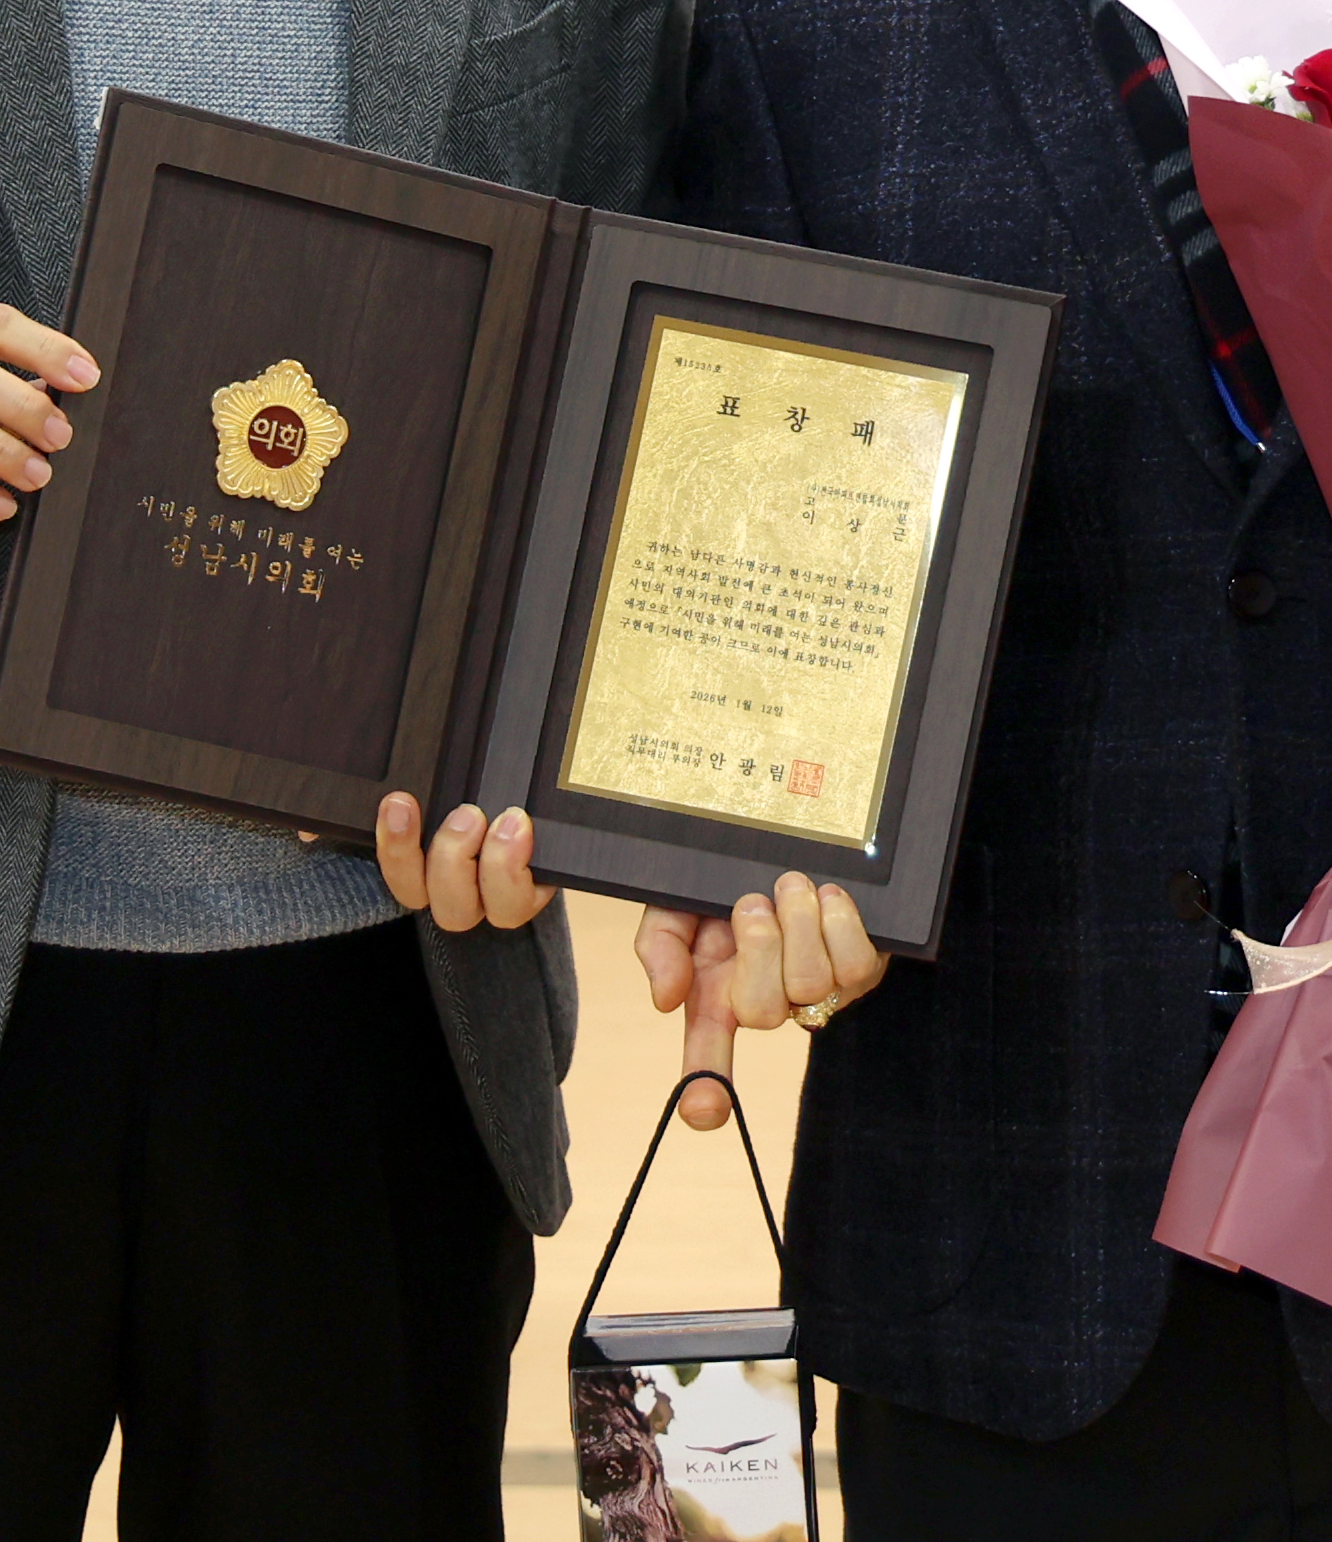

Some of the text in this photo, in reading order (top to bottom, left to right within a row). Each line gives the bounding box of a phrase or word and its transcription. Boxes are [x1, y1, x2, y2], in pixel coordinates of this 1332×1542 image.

[249, 416, 304, 457] 의회
[137, 495, 364, 570] 시민을 위해 미래를 여는
[164, 533, 325, 603] 성남시의회
[632, 559, 654, 572] 으로
[663, 564, 710, 583] 지역사회
[718, 574, 754, 591] 발전에
[778, 586, 815, 603] 초석이
[822, 595, 846, 608] 되어
[853, 600, 889, 618] 왔으며
[647, 541, 893, 598] 귀하는 남다른 사명감과 헌신적인 봉사정신
[629, 578, 885, 637] 시민의 대의기관인 의회에 대한 깊은 관심과
[722, 616, 744, 631] 위해
[750, 622, 784, 639] 미래를
[789, 630, 811, 643] 여는
[620, 616, 654, 633] 구현에
[659, 625, 693, 641] 기여한
[699, 632, 721, 646] 공이
[727, 638, 761, 653] 크므로
[766, 646, 789, 660] 이에
[690, 690, 784, 717] 2026년 1월 12일
[629, 733, 680, 753] 성남시의회
[685, 1458, 779, 1474] KAIKEN
